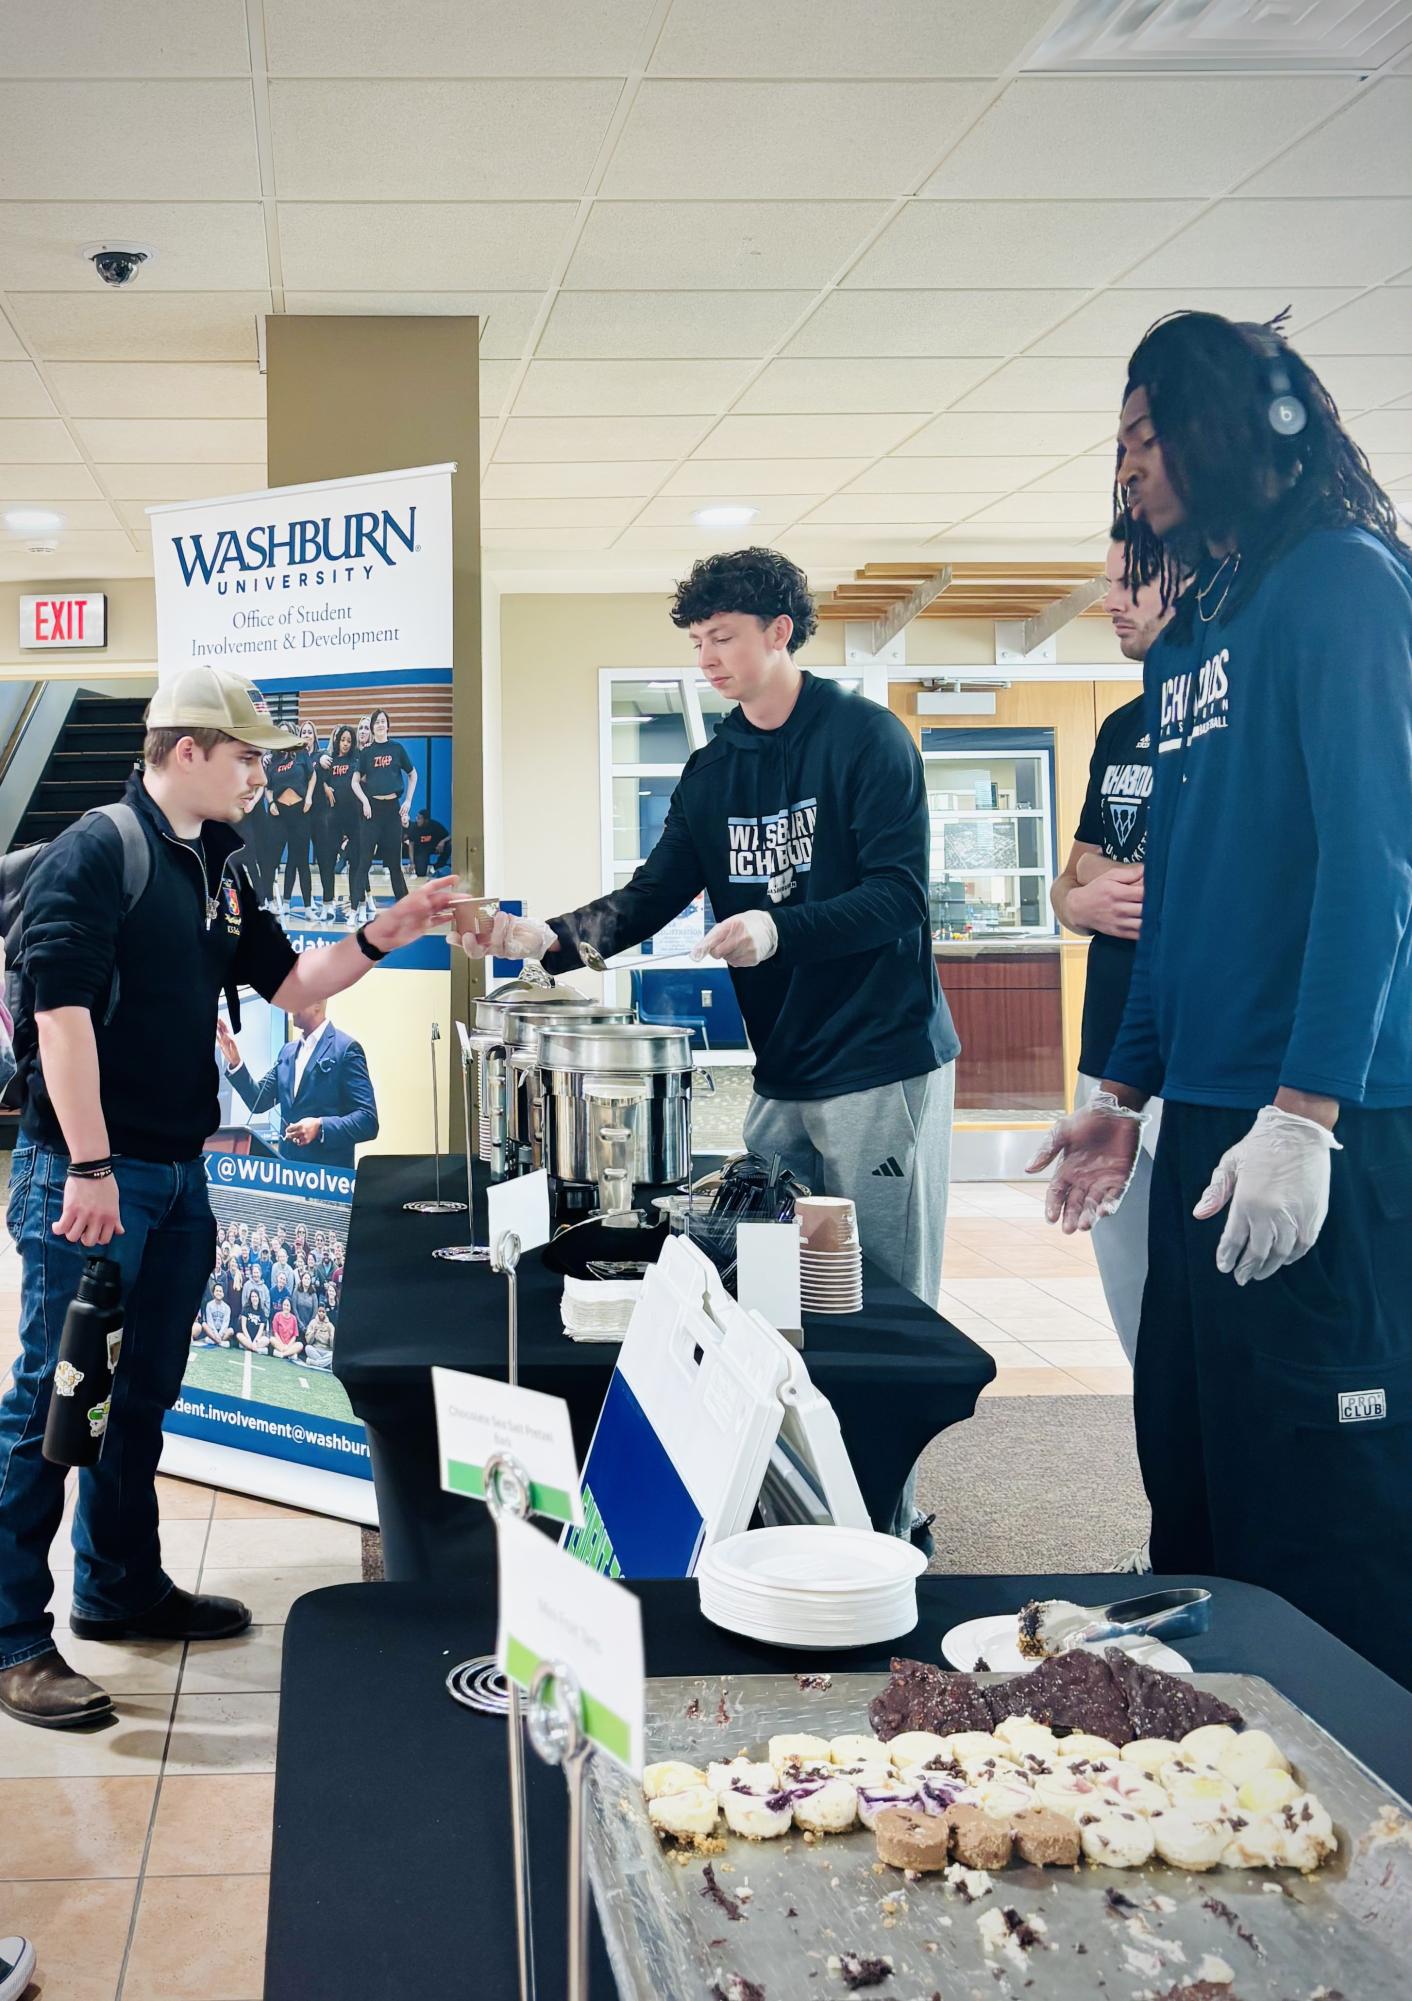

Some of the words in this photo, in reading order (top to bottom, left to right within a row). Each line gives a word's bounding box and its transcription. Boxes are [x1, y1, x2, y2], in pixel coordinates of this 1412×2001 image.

[172, 506, 416, 587] WASHBURN
[217, 565, 374, 595] UNIVERSITY
[35, 600, 87, 640] EXIT
[232, 610, 274, 629] Office
[278, 606, 294, 625] of
[296, 603, 352, 623] Student
[191, 636, 278, 656] Involvement
[283, 633, 296, 649] &
[302, 627, 400, 650] Development
[1344, 1404, 1382, 1417] CLUB
[1347, 1395, 1377, 1407] PRO
[170, 1399, 370, 1458] dent.involvement@washbur
